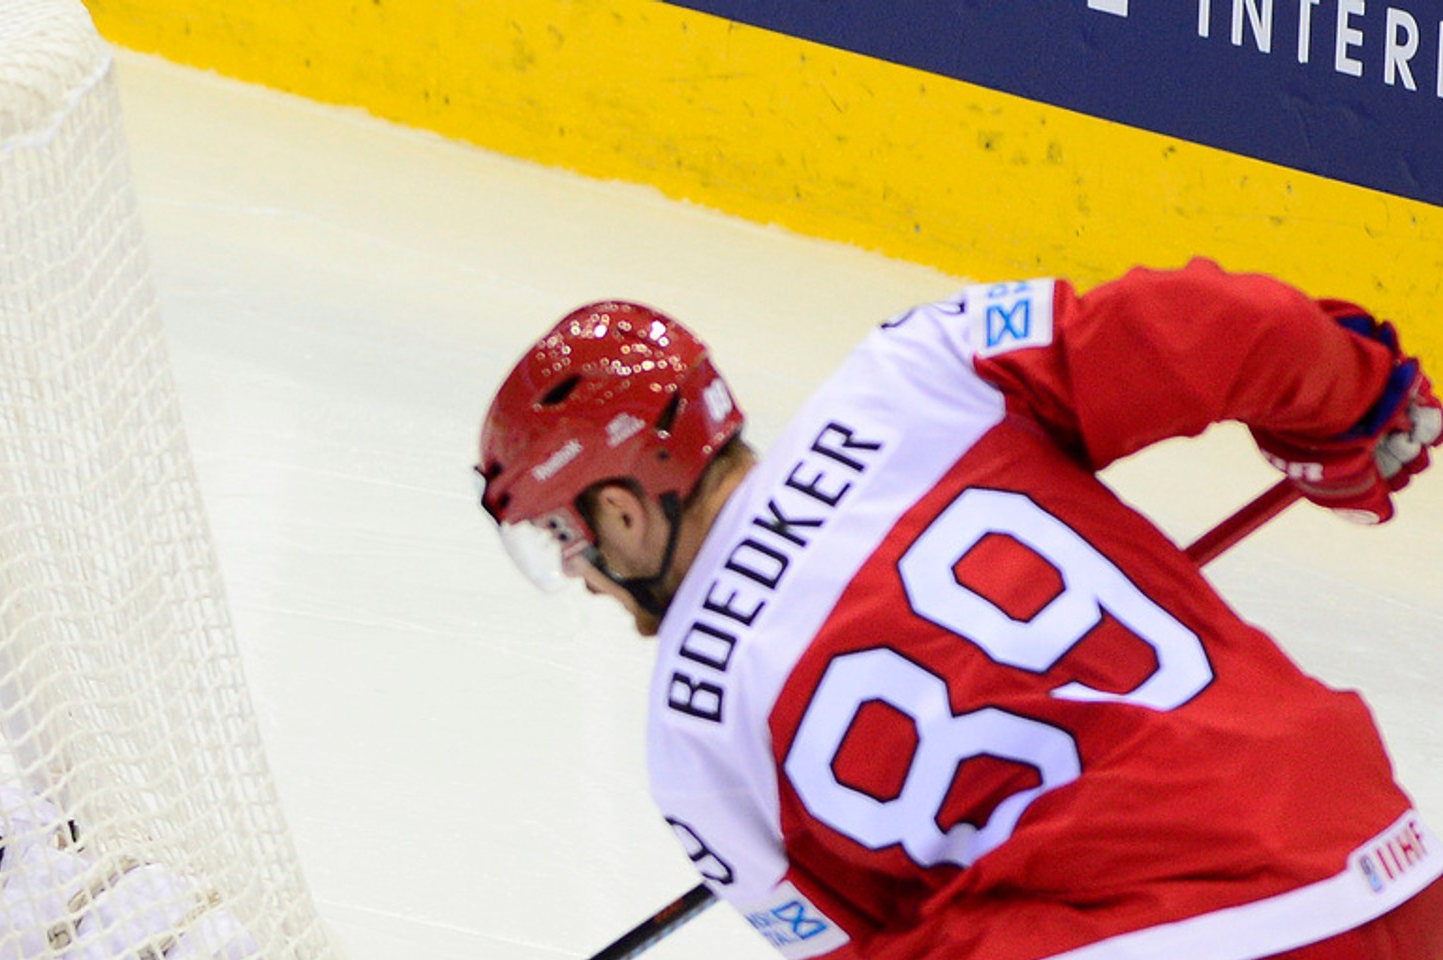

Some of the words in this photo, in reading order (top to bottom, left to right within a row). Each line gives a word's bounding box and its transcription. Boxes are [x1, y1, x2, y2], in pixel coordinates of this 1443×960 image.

[1198, 0, 1443, 98] INTER
[668, 422, 883, 723] BOEDKER
[783, 485, 1217, 869] 89
